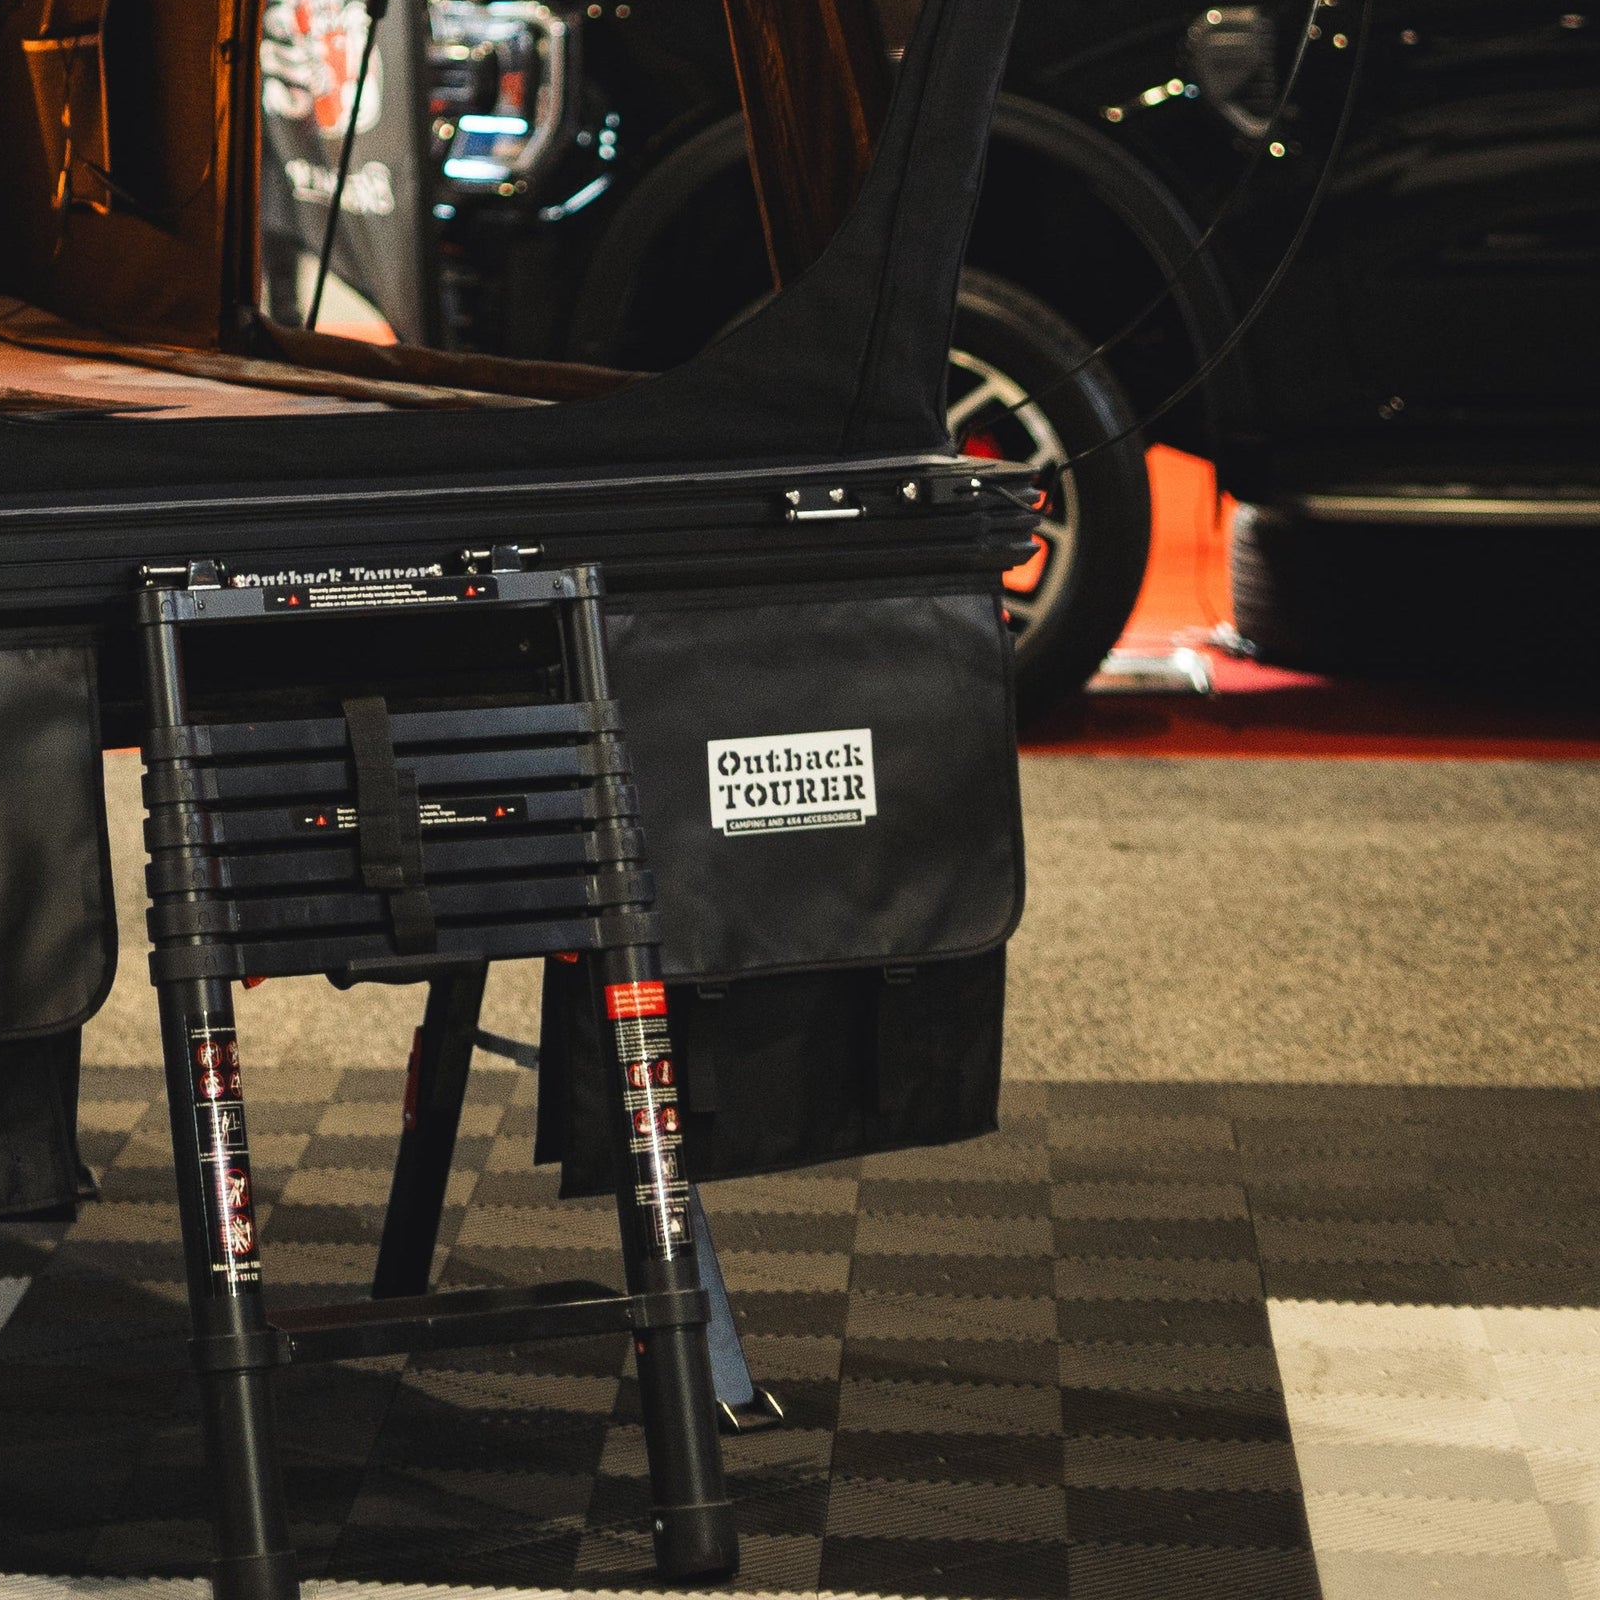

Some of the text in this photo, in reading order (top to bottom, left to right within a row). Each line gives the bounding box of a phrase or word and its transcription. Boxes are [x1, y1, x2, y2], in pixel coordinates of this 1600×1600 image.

[717, 743, 863, 776] Outback
[719, 774, 866, 809] TOURER
[729, 819, 766, 830] CAMPING
[768, 818, 784, 827] AND
[802, 812, 858, 824] ACCESSORIES
